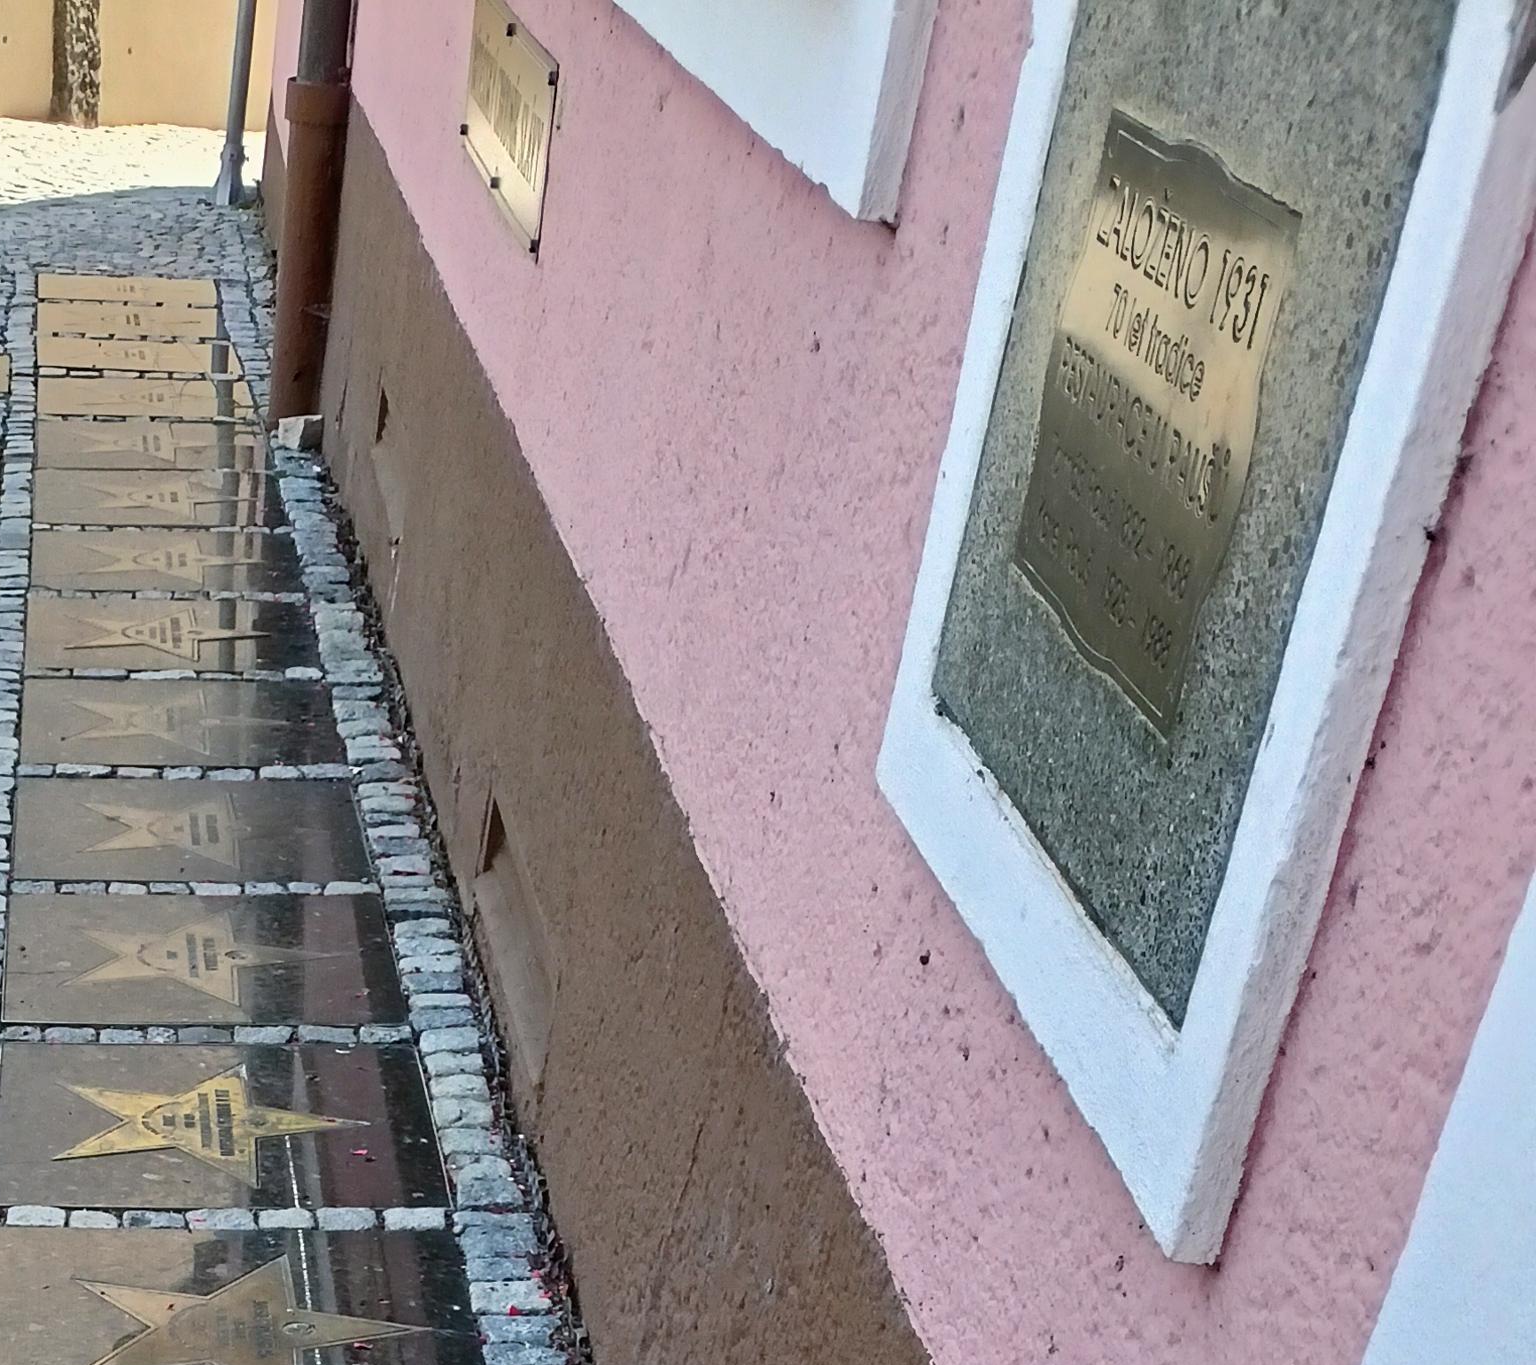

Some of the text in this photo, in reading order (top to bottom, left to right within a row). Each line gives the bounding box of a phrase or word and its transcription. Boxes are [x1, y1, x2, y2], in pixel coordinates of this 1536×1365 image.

[1096, 174, 1270, 350] ZALOŽENO 1931
[1105, 282, 1205, 402] 70 let tradice
